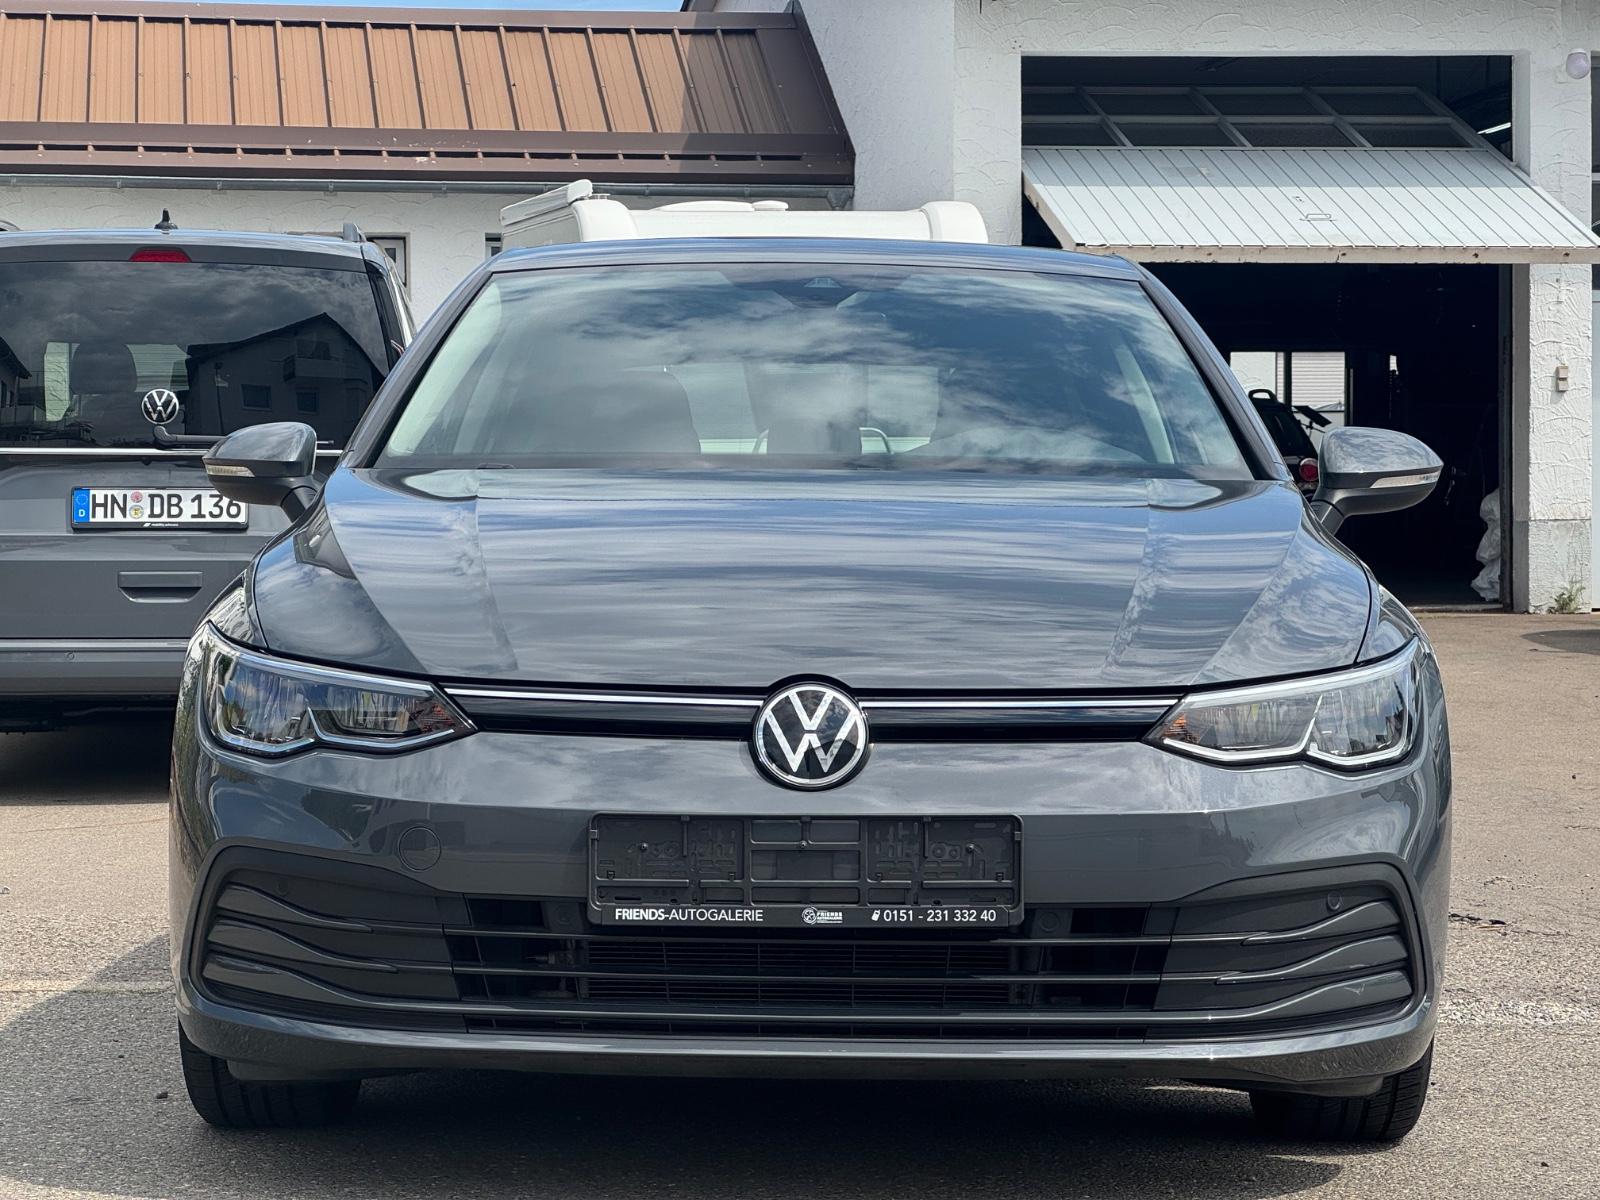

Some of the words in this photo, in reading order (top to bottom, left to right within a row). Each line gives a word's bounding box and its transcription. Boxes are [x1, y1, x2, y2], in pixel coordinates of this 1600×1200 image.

[78, 509, 86, 517] D
[91, 494, 128, 519] HN
[148, 494, 184, 519] DB
[190, 494, 242, 519] 136
[615, 908, 764, 922] FRIENDS-AUTOGALERIE
[883, 909, 914, 922] 0151
[926, 909, 949, 922] 231
[953, 909, 977, 922] 332
[980, 909, 997, 922] 40
